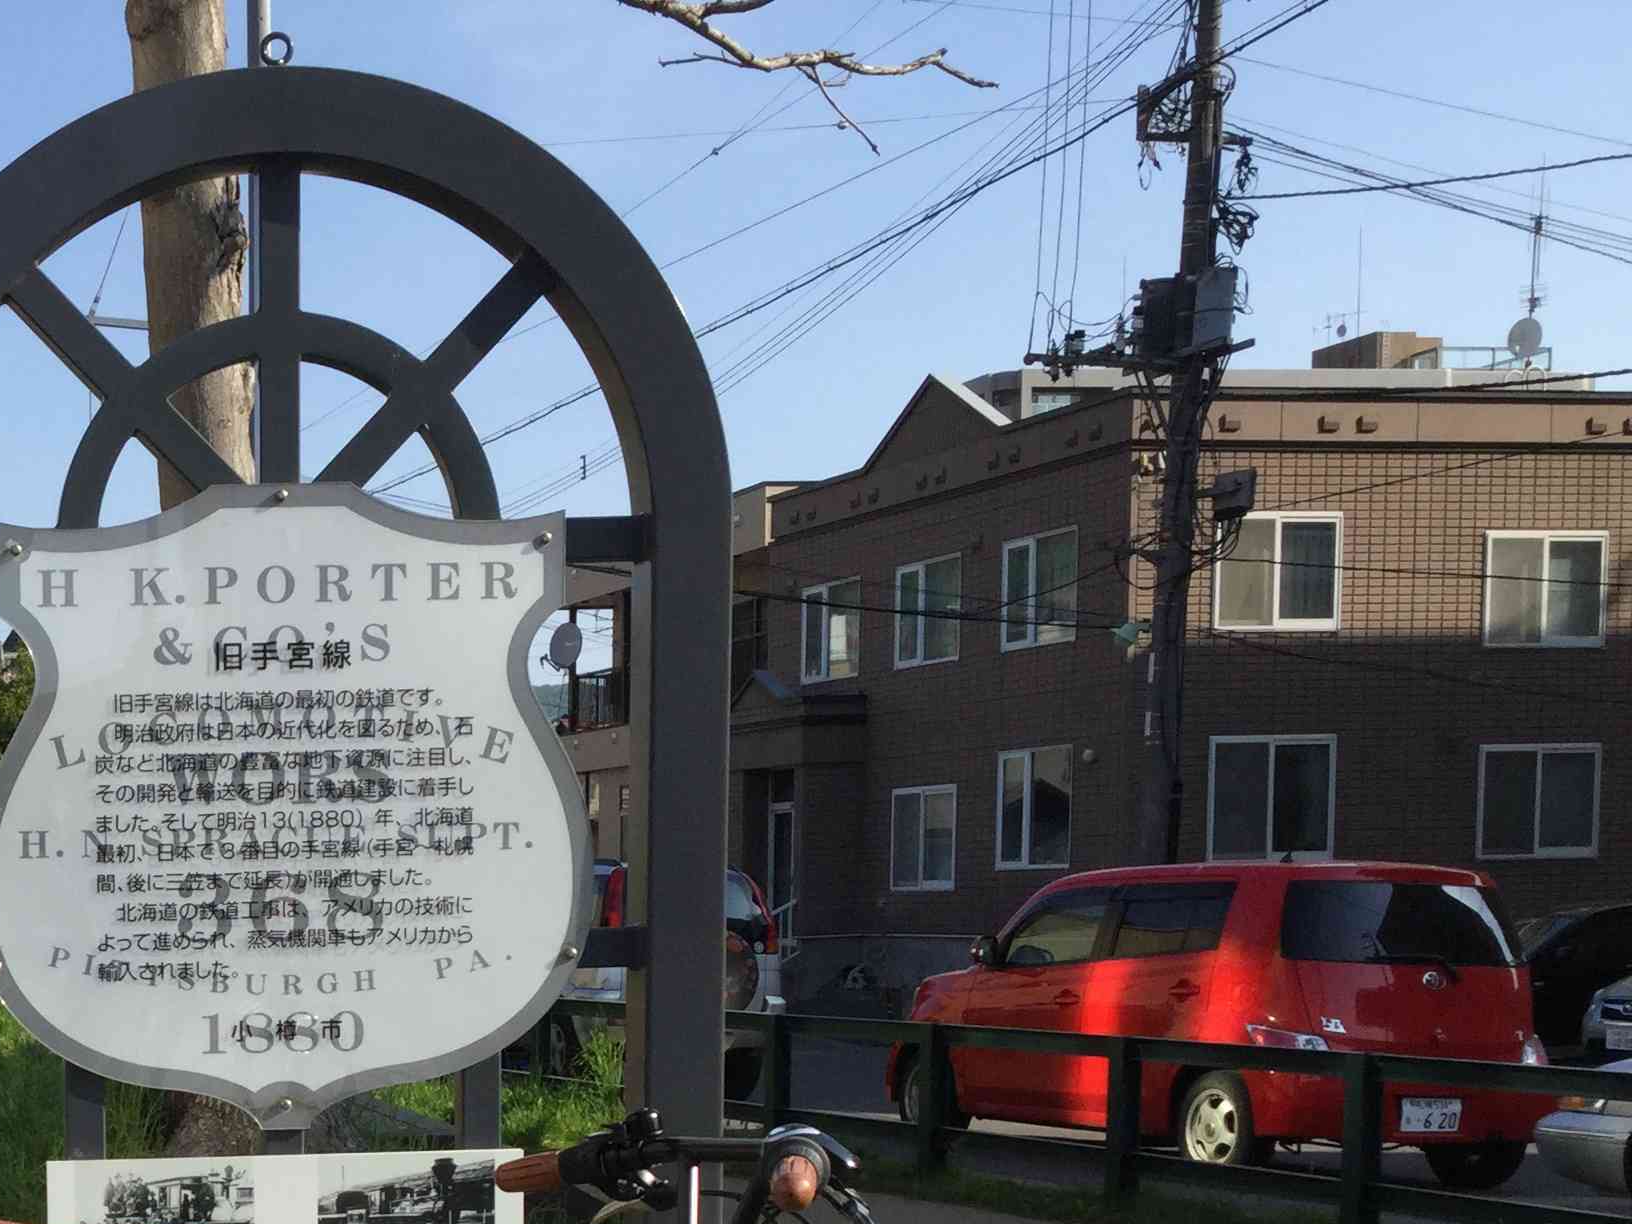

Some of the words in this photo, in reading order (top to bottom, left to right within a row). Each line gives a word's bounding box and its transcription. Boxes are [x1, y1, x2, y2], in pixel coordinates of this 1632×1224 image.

[37, 568, 79, 608] H
[153, 626, 193, 666] &
[215, 639, 352, 672] 旧手宮線
[114, 687, 443, 713] 旧手宮線は北海道の最初の鉄道です。
[97, 959, 239, 983] 輸入されました。
[200, 1010, 364, 1055] 1880
